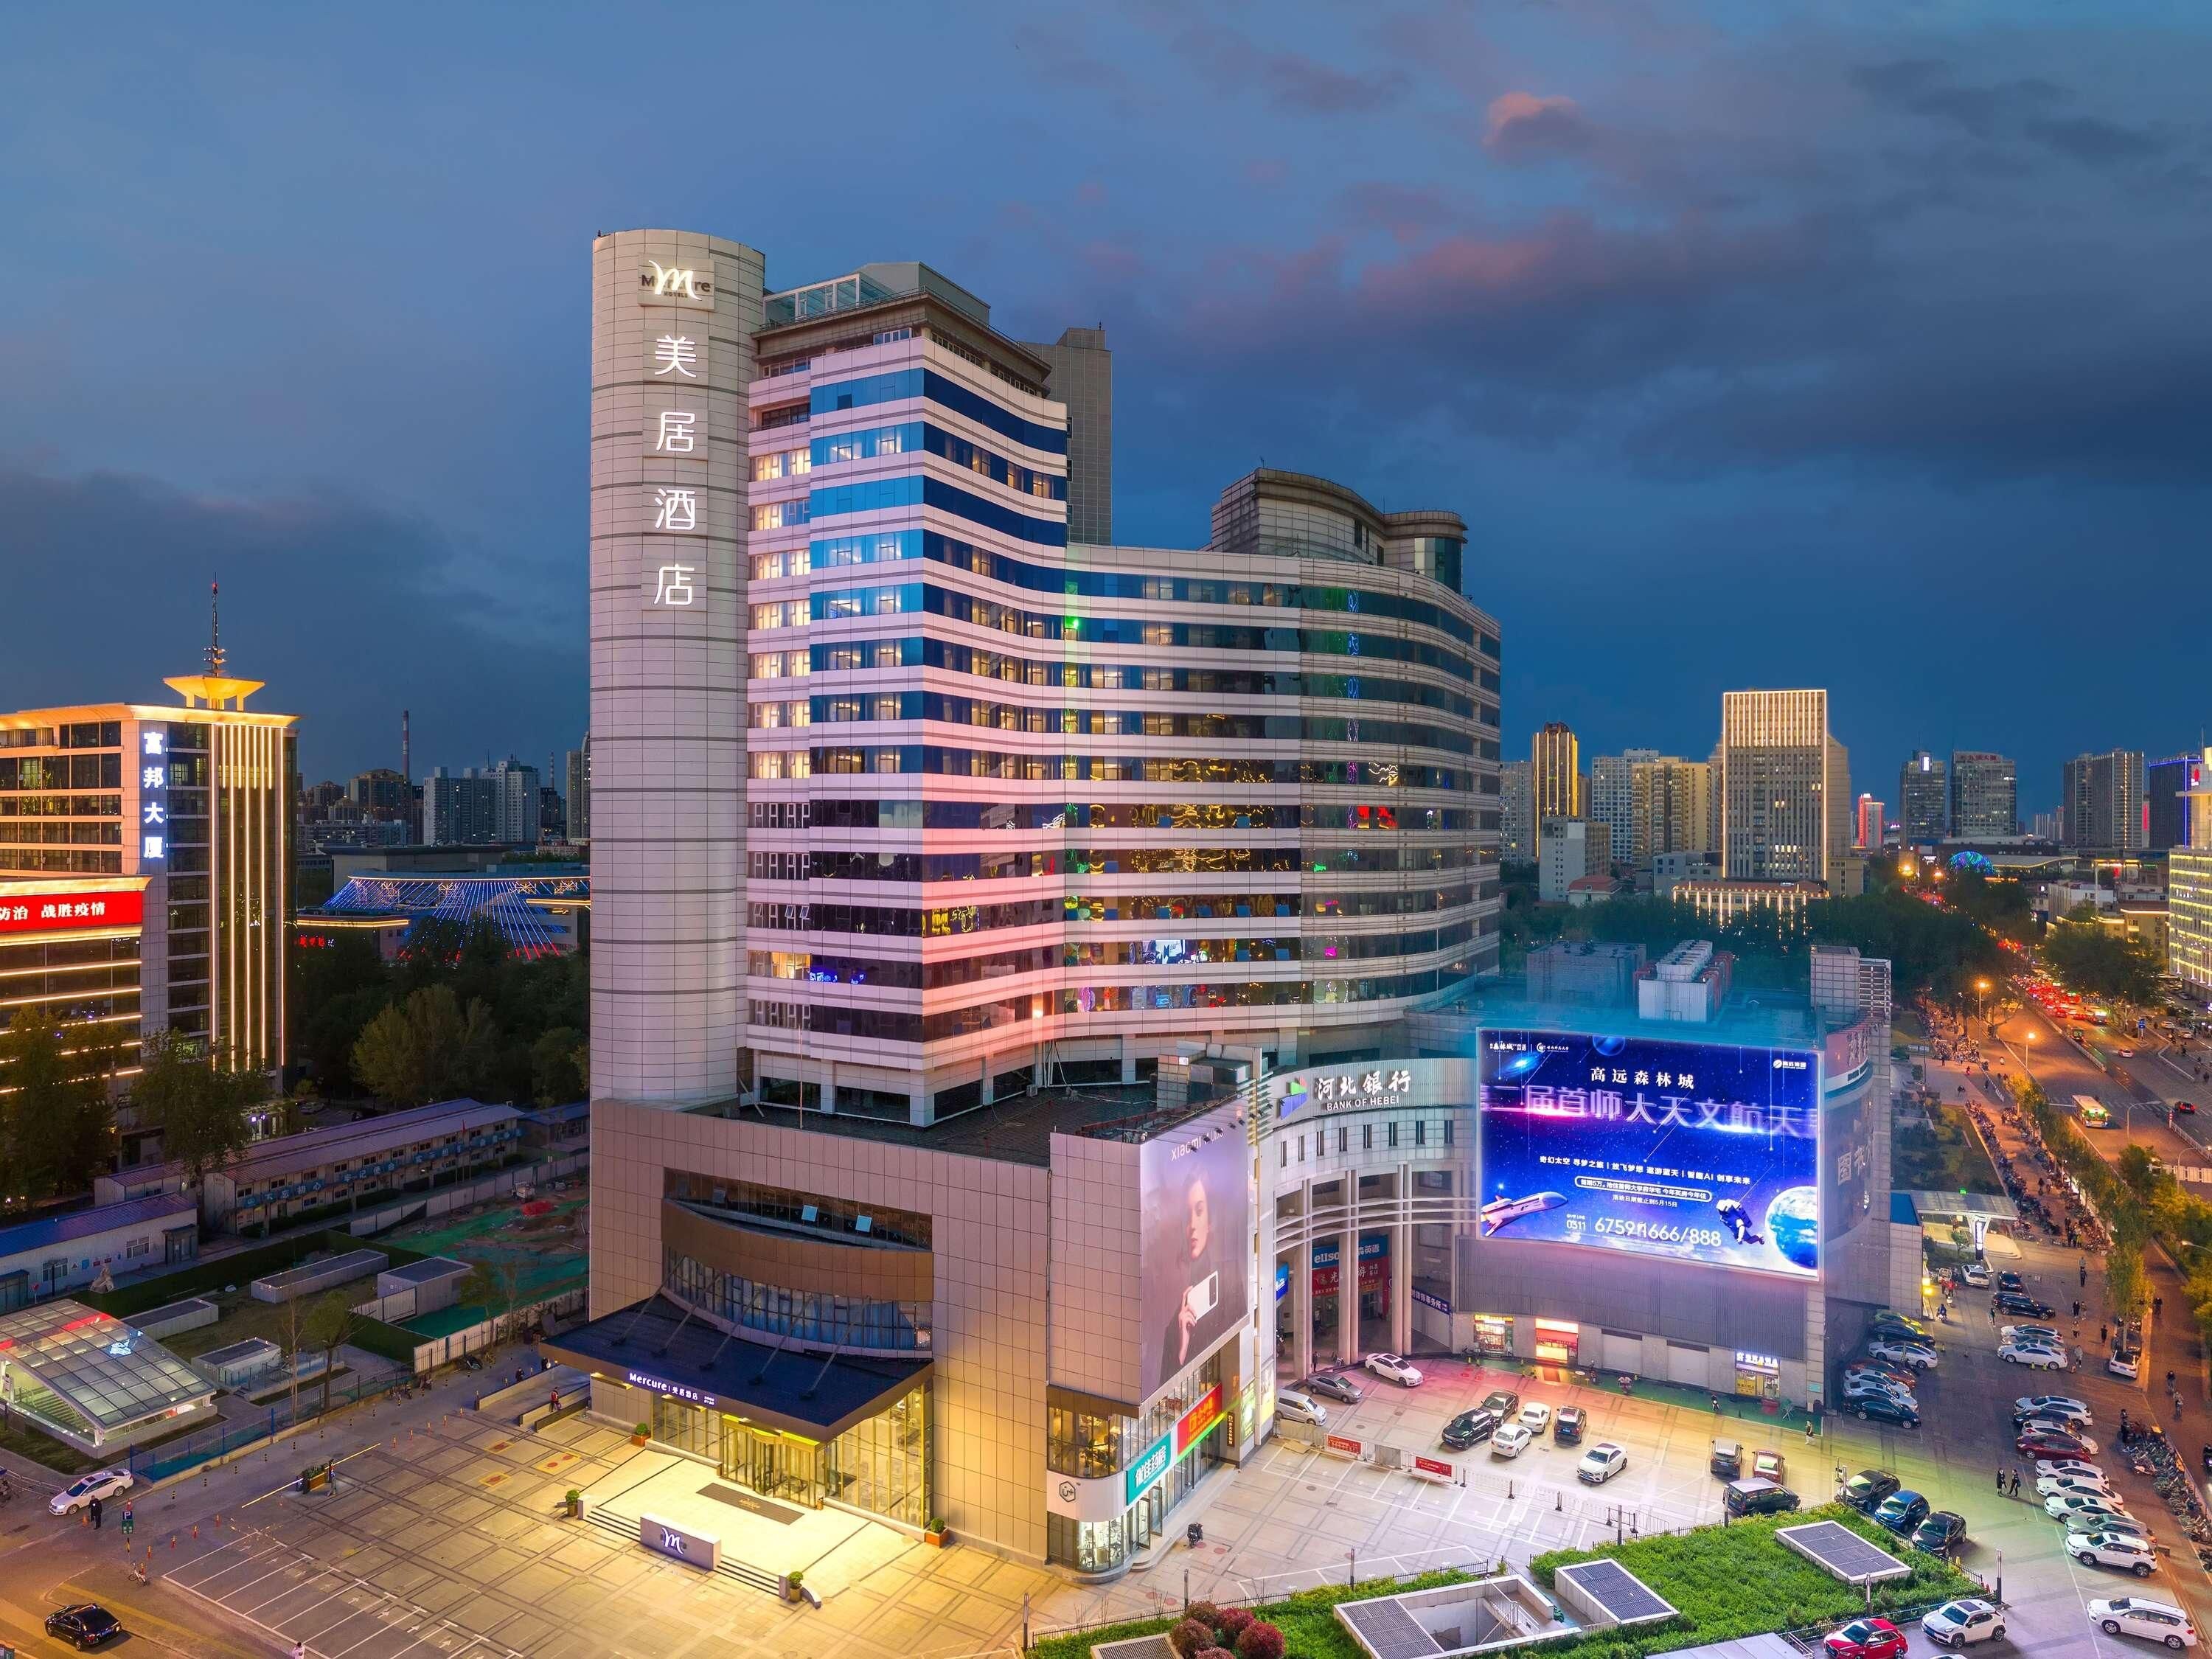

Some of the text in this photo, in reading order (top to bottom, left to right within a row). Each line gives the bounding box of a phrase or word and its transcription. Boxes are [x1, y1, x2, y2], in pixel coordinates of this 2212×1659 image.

[654, 335, 697, 606] 美居酒店
[41, 902, 105, 919] 战胜疫情
[1591, 1067, 1694, 1089] 高远森林城
[1327, 1095, 1399, 1111] BANK OF HEBEI
[1481, 1085, 1817, 1139] 二届首师大天文航天
[1540, 1156, 1570, 1165] 奇幻太空
[1573, 1158, 1604, 1169] 寻梦之旅
[1612, 1163, 1644, 1173] 放飞梦想
[629, 1373, 667, 1391] Mercure
